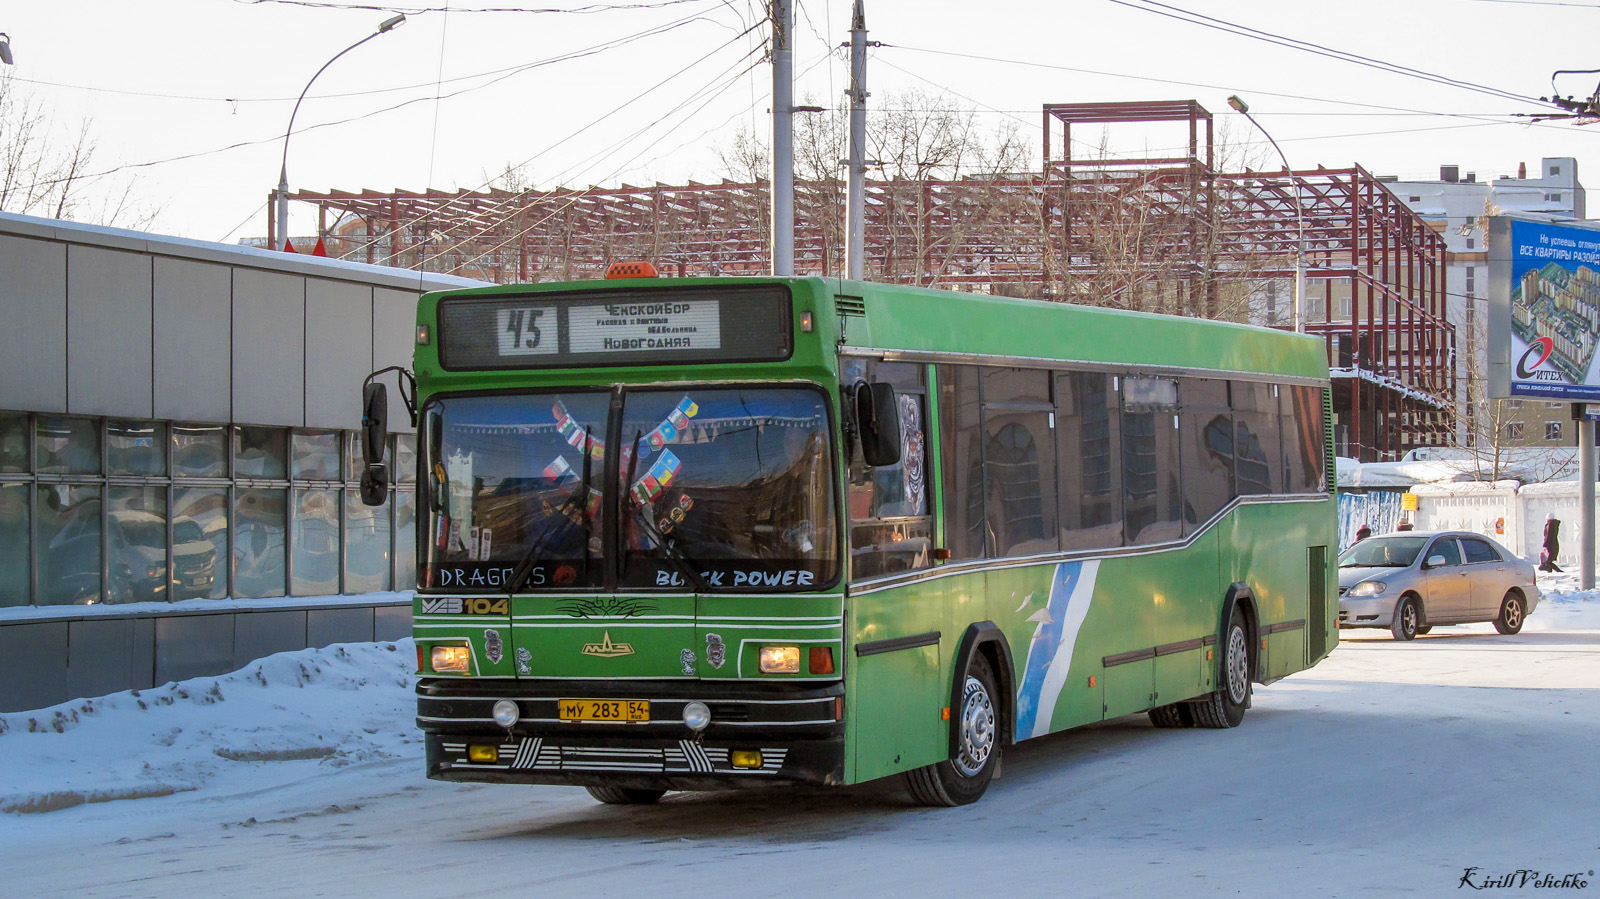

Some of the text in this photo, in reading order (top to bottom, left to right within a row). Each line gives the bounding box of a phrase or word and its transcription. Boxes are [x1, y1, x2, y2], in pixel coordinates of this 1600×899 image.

[1540, 234, 1549, 244] Не
[1551, 237, 1576, 247] успеешь
[1520, 245, 1533, 256] ВСЕ
[1535, 247, 1571, 260] КВАРТИРЫ
[506, 310, 544, 348] 45
[441, 566, 545, 586] DRAGOS
[656, 570, 814, 587] BLK POWER
[464, 598, 508, 615] 104
[592, 703, 619, 718] 283
[629, 702, 644, 714] 54
